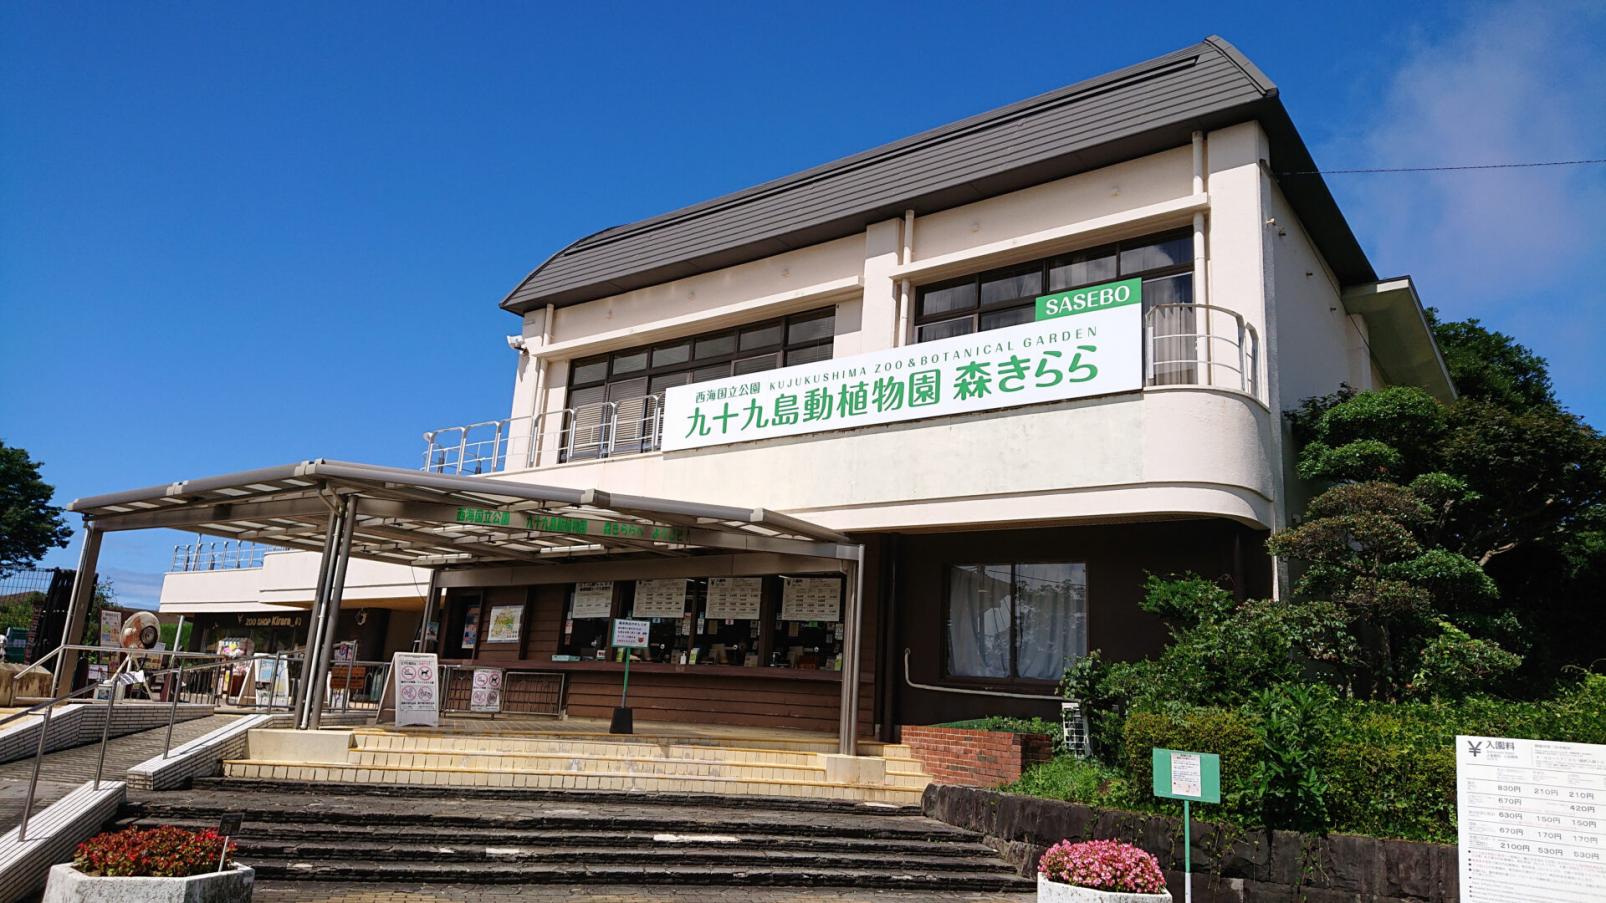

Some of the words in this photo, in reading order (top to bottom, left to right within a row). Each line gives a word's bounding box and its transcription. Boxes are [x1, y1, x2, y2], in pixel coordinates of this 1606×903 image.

[1045, 285, 1130, 315] SASEBO
[769, 367, 867, 391] KUJUKUSHIMA
[1023, 325, 1098, 348] GARDEN
[685, 368, 942, 440] 九十九島動植物園
[953, 345, 1098, 401] 森きらら
[695, 381, 761, 404] 西海国立公園
[1486, 740, 1515, 751] 入園料
[1569, 791, 1594, 800] 210円
